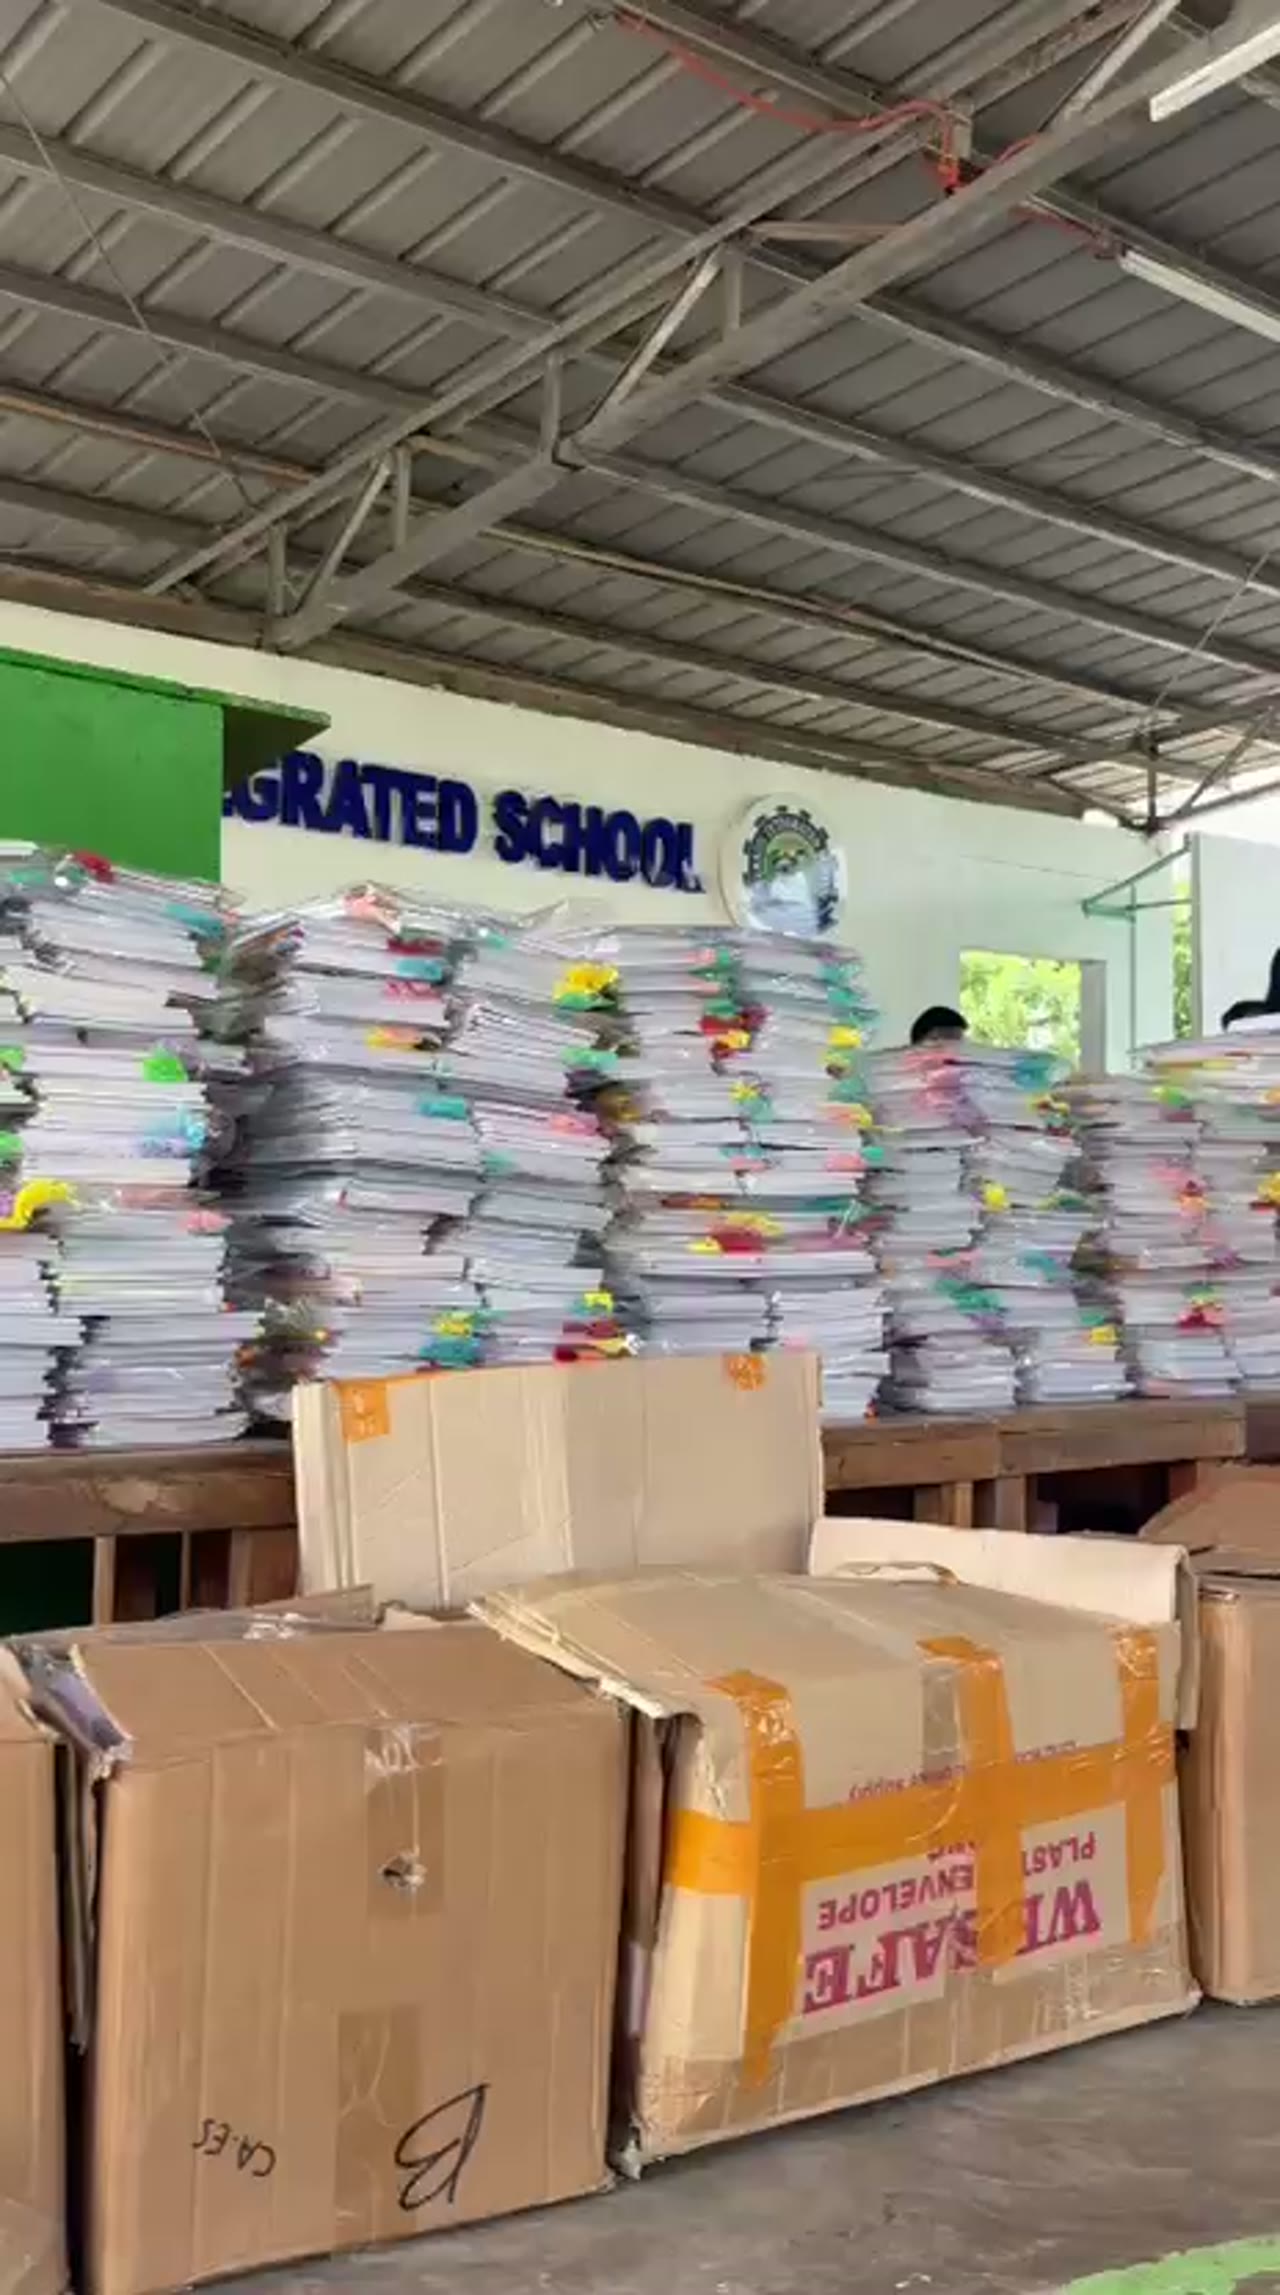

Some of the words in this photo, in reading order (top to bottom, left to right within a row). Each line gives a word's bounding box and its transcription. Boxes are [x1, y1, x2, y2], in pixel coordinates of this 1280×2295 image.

[222, 751, 478, 854] GRATED
[493, 790, 706, 893] SCHOOL
[817, 1864, 974, 1931] ENVELOPE
[1020, 1831, 1096, 1877] PLAST
[394, 2083, 490, 2212] B
